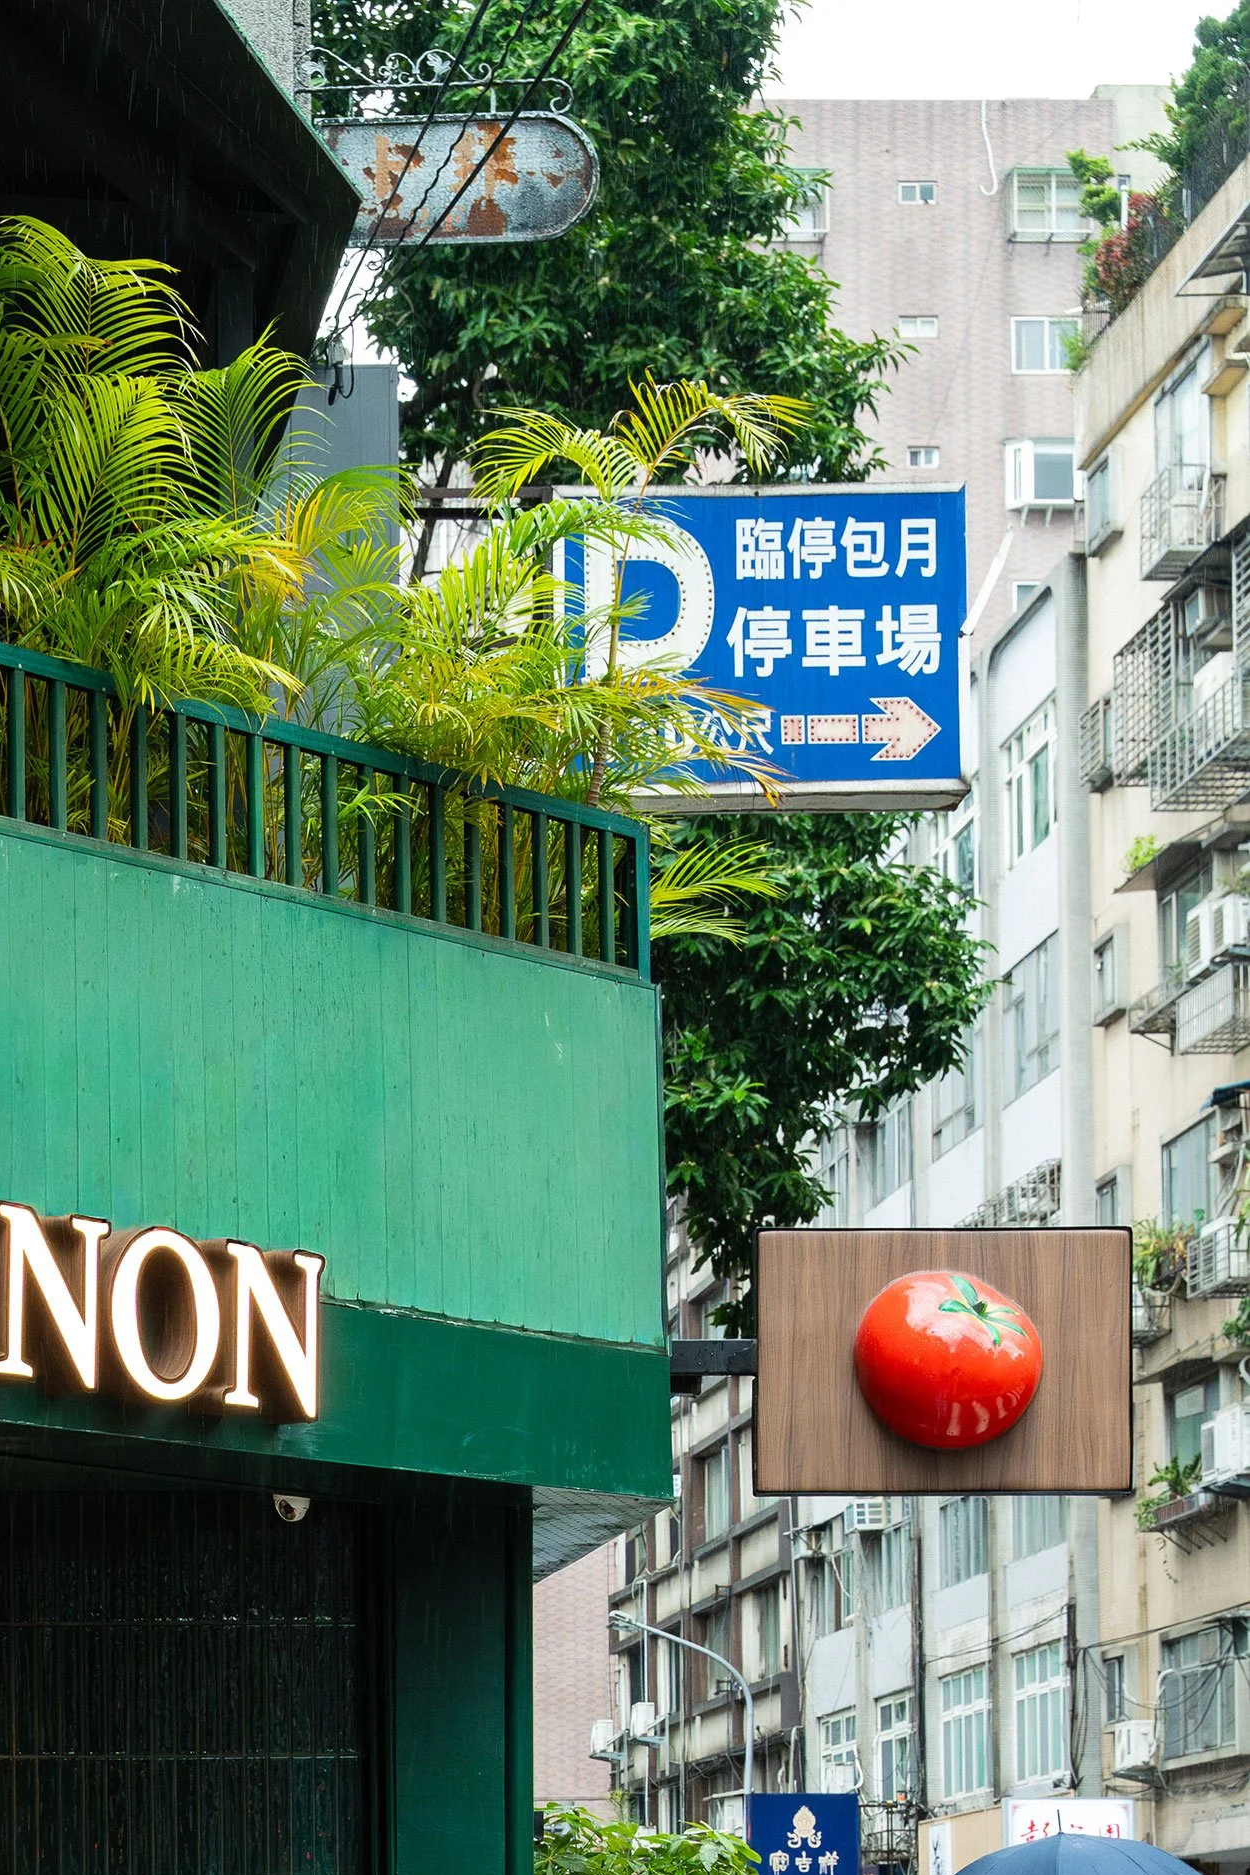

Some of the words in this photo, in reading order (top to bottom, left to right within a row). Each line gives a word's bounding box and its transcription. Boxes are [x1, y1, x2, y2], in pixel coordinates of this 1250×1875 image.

[735, 516, 937, 580] 臨停包月
[726, 605, 942, 678] 停車場
